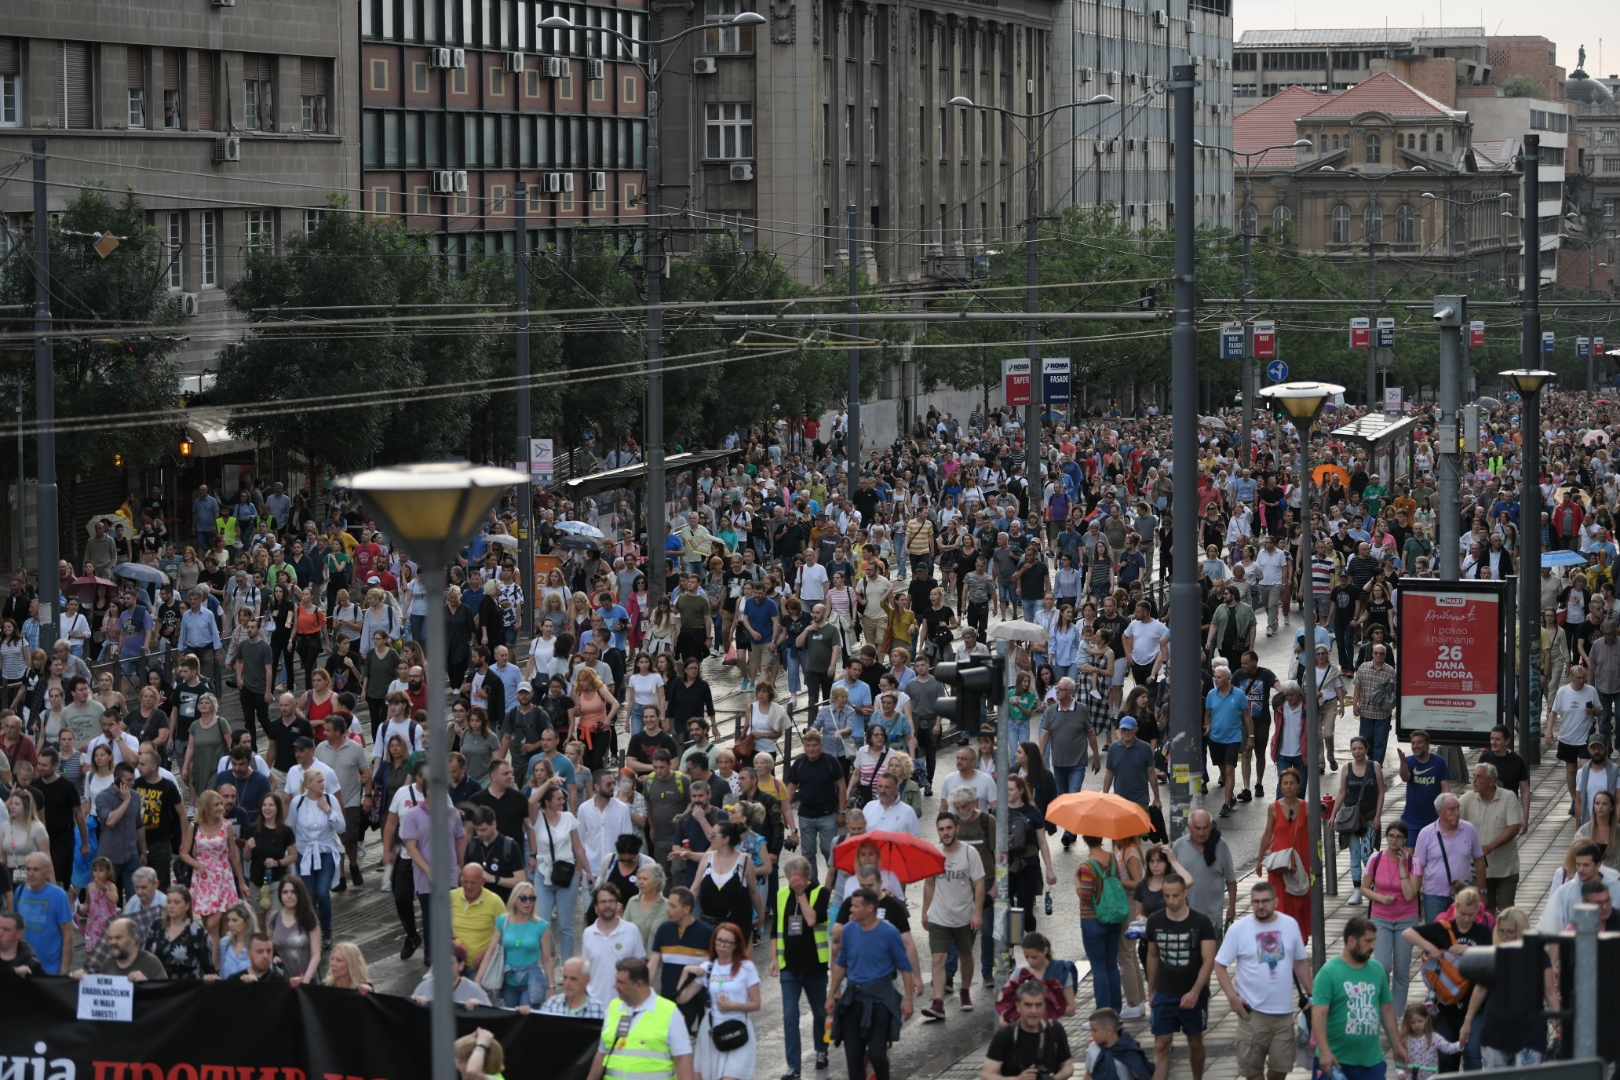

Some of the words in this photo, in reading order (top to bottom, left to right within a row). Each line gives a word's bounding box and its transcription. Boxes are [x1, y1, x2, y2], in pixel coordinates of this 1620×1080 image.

[1013, 376, 1029, 384] TAPETE
[1050, 375, 1068, 383] FASADE
[1439, 627, 1467, 635] posao
[1431, 635, 1475, 645] najmanje
[1438, 646, 1462, 660] 26
[1435, 661, 1465, 670] DANA
[1427, 670, 1473, 679] ODMORA
[1413, 775, 1436, 786] BARÇA
[97, 977, 113, 985] NEMA
[99, 1000, 115, 1008] MALO
[91, 1009, 114, 1018] SAVESTI
[0, 1041, 77, 1080] ија
